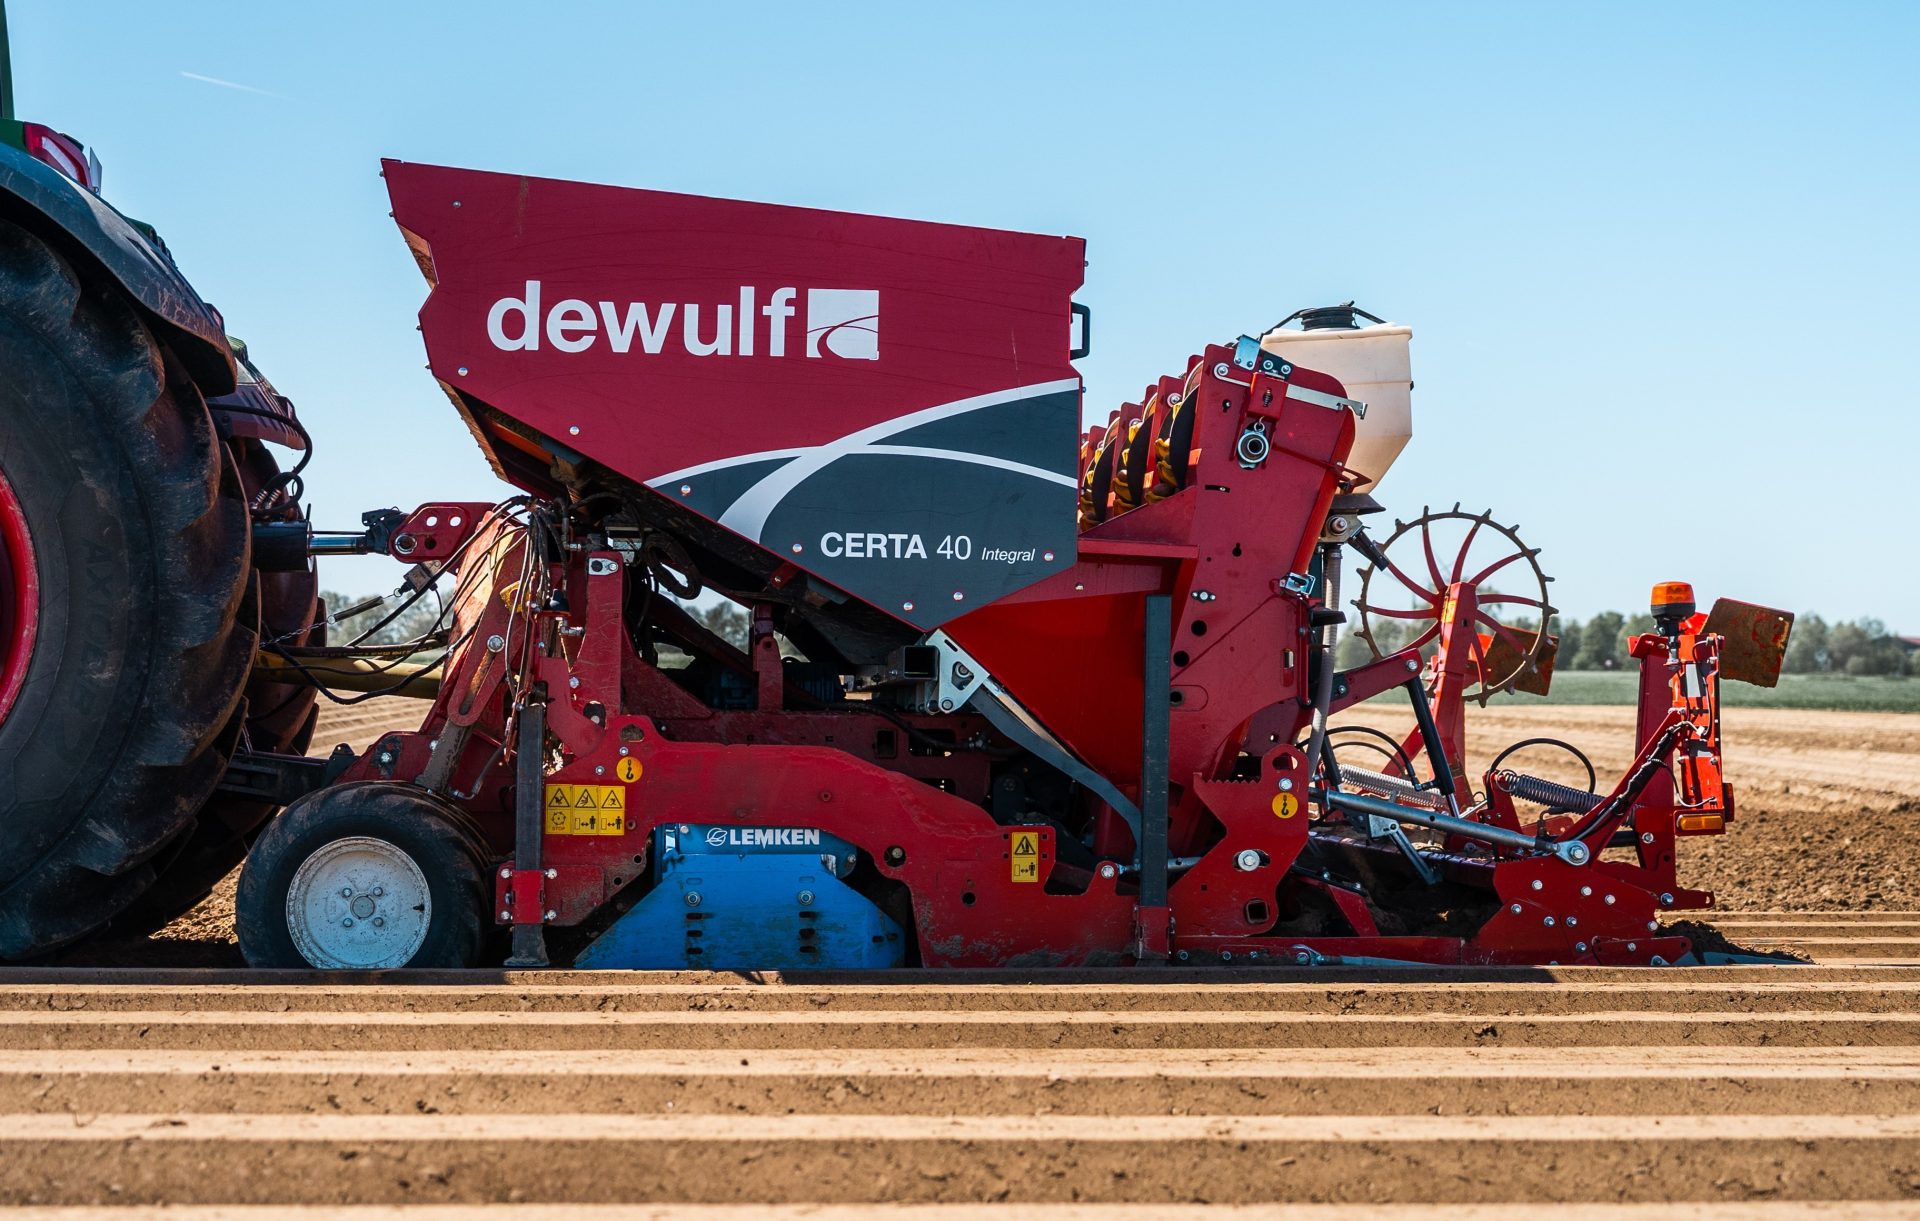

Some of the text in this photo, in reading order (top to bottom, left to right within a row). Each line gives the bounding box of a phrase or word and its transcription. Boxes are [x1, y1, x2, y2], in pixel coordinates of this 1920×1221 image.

[487, 280, 797, 357] dewulf
[821, 532, 1036, 565] CERTA 40 Integral
[729, 829, 820, 848] LEMKEN
